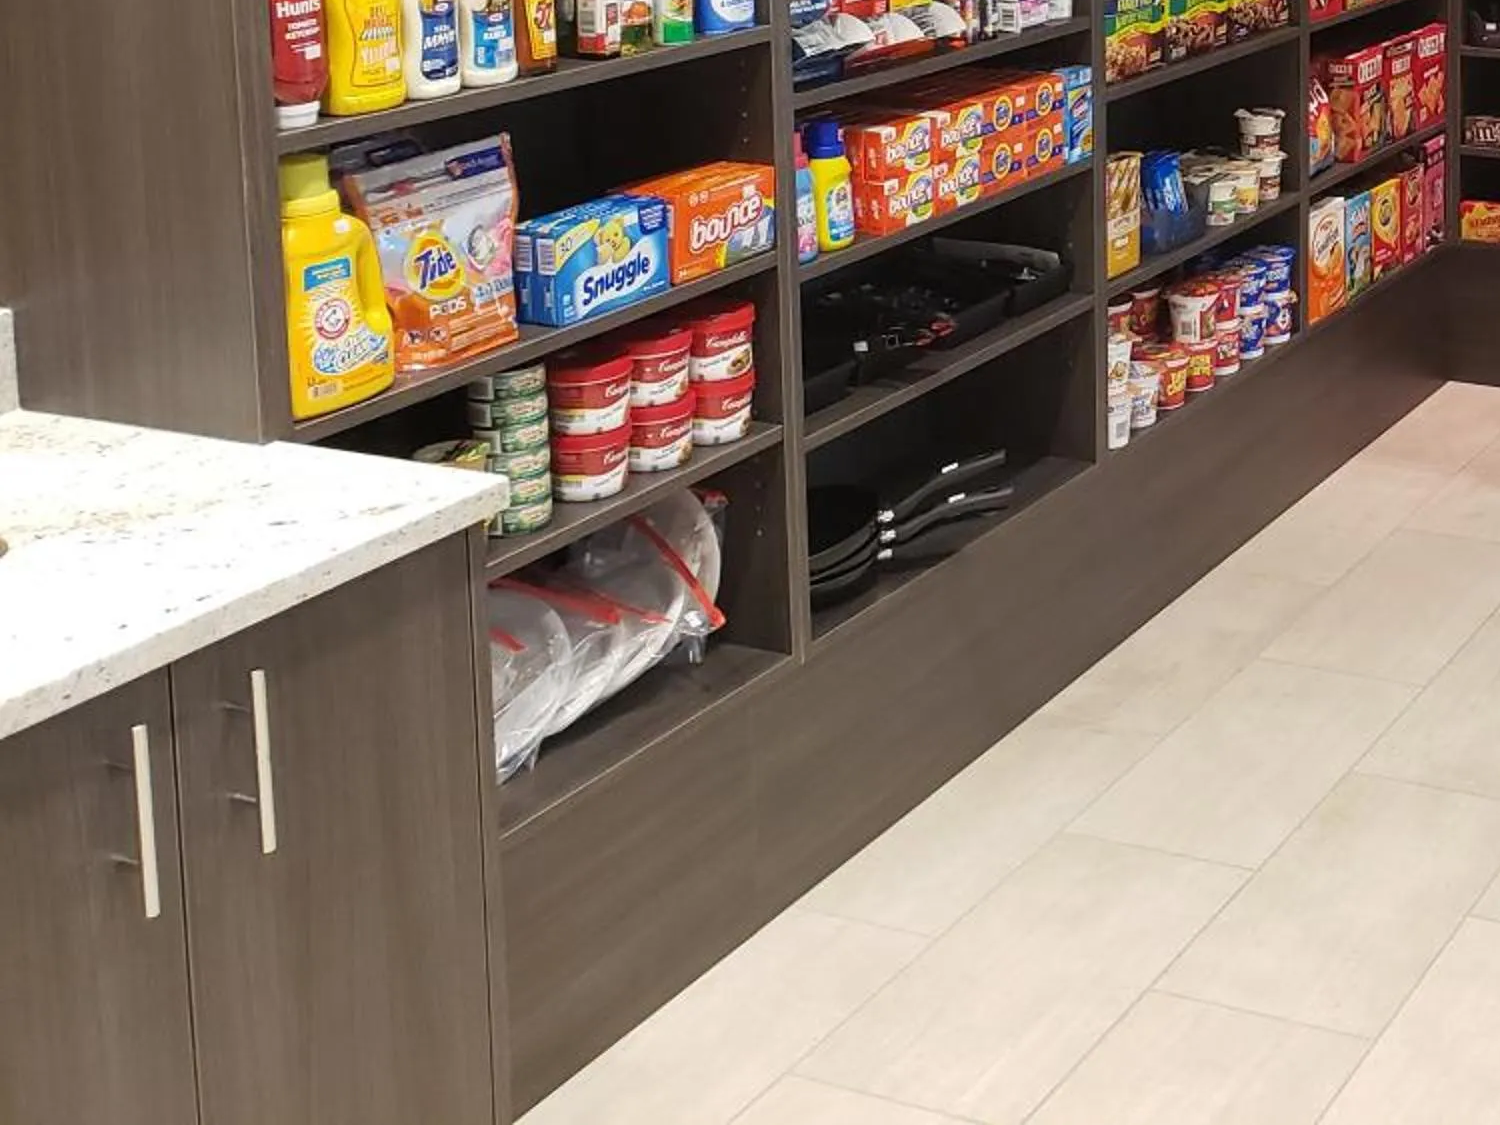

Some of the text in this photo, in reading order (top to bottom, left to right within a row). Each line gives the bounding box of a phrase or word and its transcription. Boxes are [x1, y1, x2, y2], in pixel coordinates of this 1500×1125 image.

[691, 195, 763, 252] bounce
[414, 247, 456, 291] Tide
[582, 253, 651, 306] Snuggle
